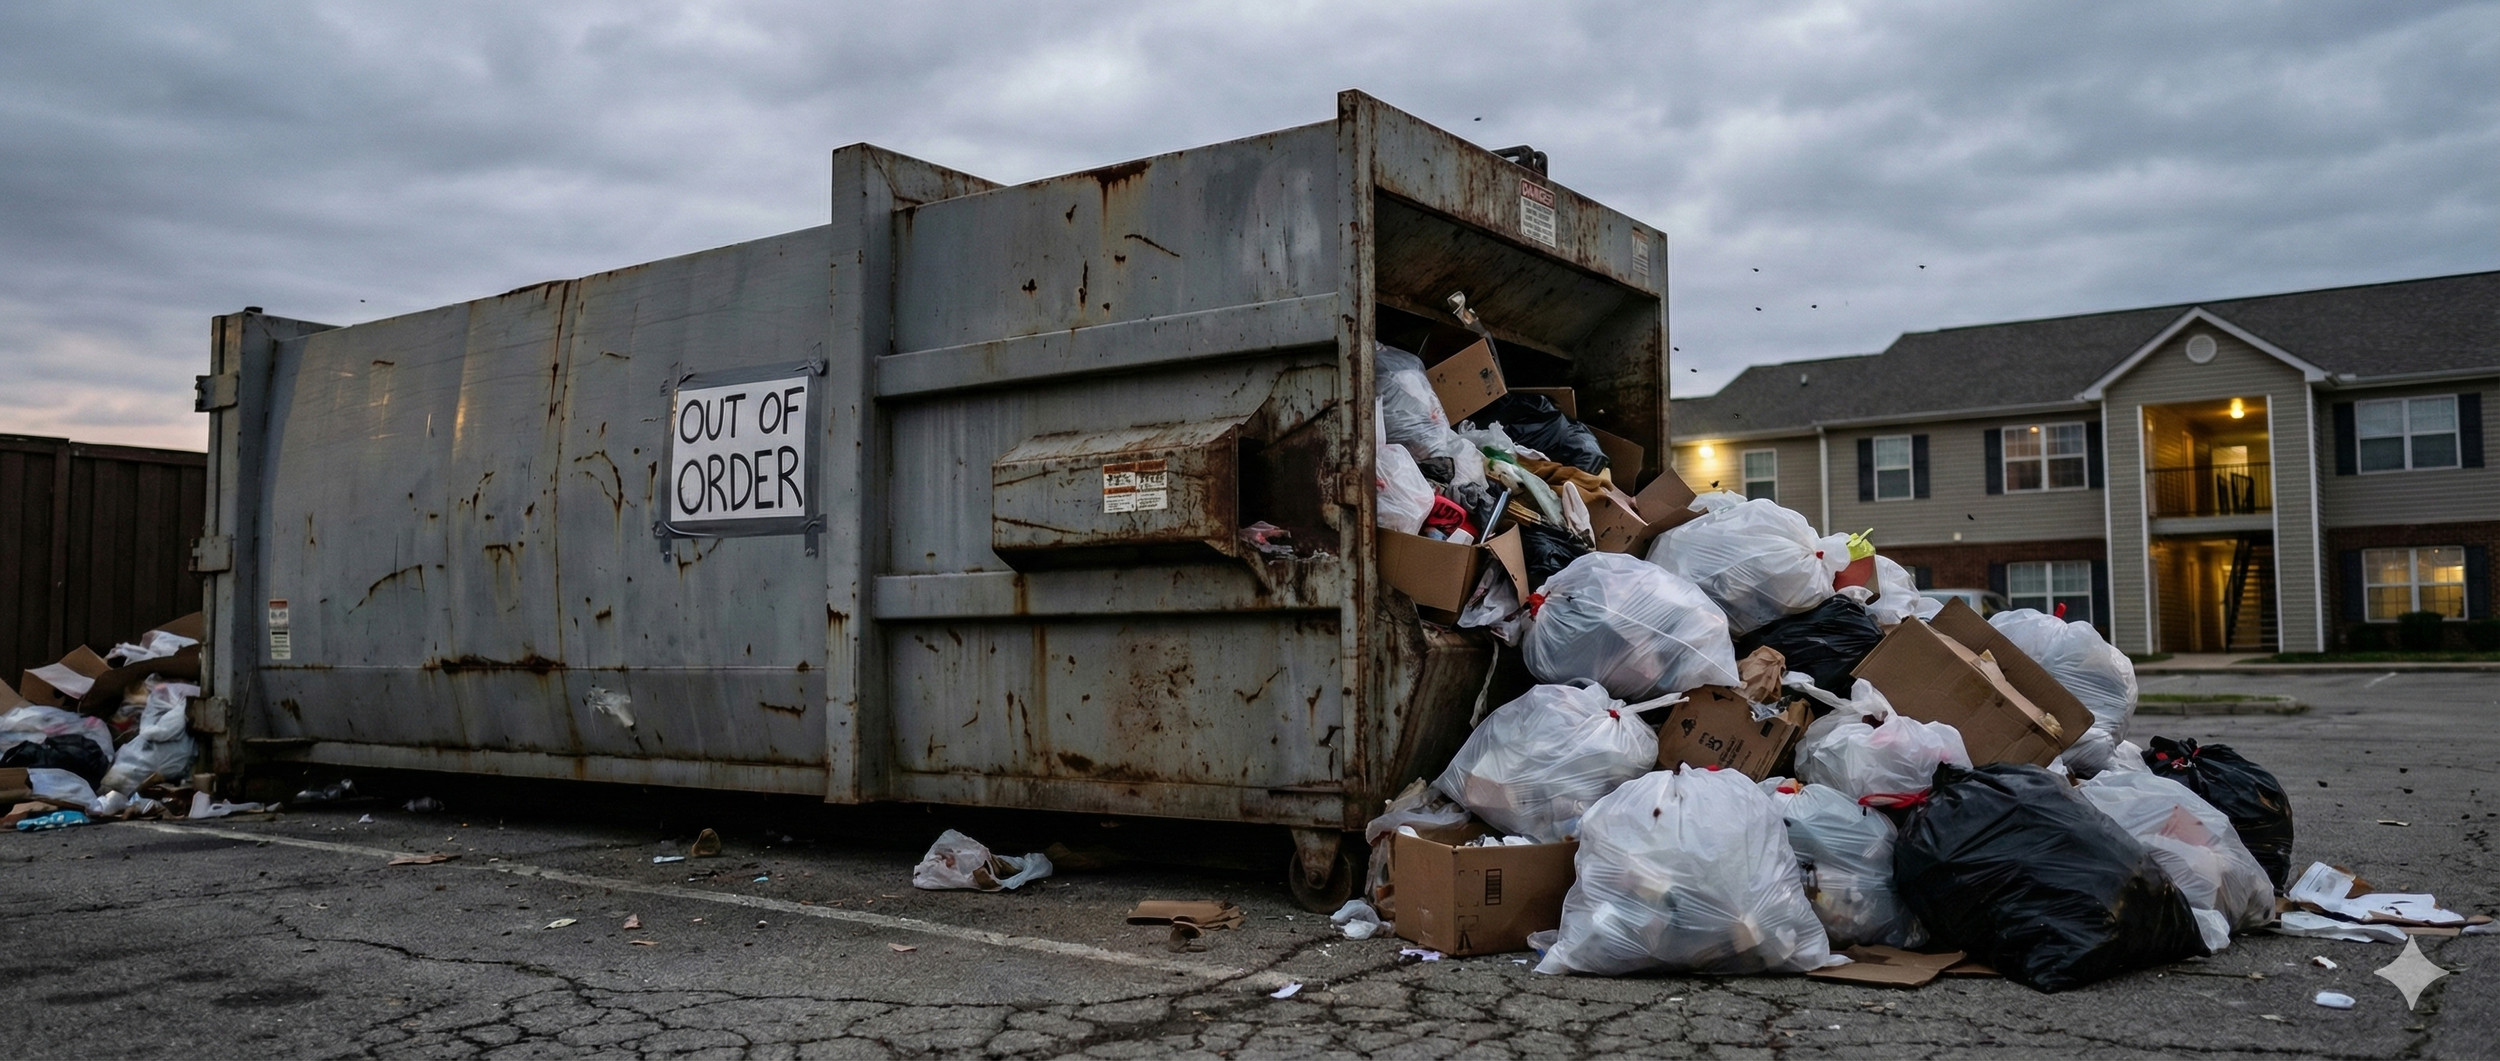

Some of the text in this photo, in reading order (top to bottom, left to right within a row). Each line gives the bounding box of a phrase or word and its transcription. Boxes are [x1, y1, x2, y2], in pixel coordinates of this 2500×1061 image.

[680, 386, 804, 444] OUT OF
[678, 445, 803, 515] ORDER
